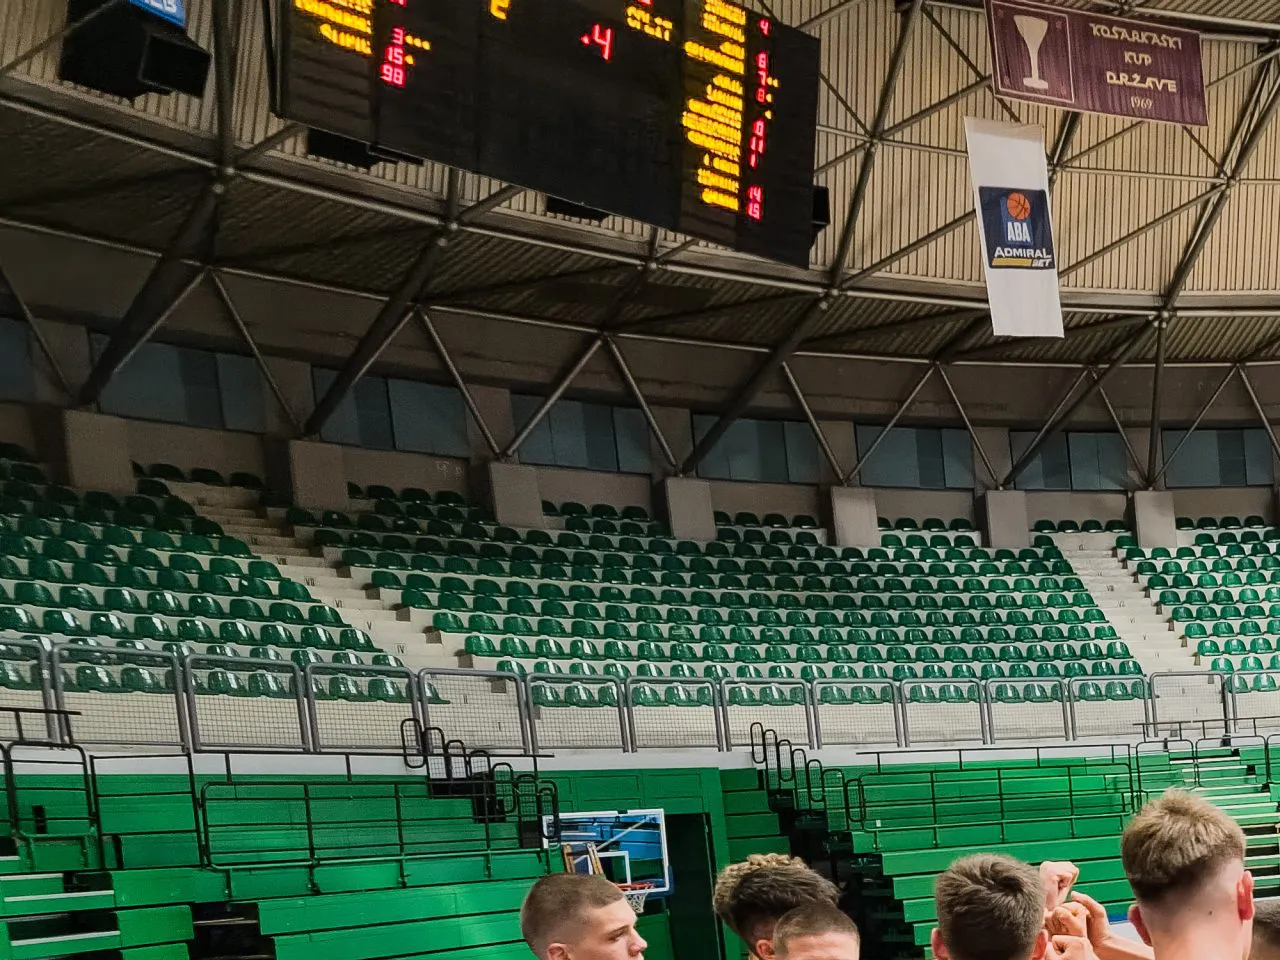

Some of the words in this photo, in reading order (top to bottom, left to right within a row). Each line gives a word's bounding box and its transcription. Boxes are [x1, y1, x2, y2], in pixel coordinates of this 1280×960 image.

[1124, 51, 1152, 66] KUP
[1106, 71, 1177, 93] DRŽAVE
[1131, 95, 1153, 110] 1969
[1007, 221, 1031, 243] ABA
[994, 247, 1052, 259] ADMIRAL
